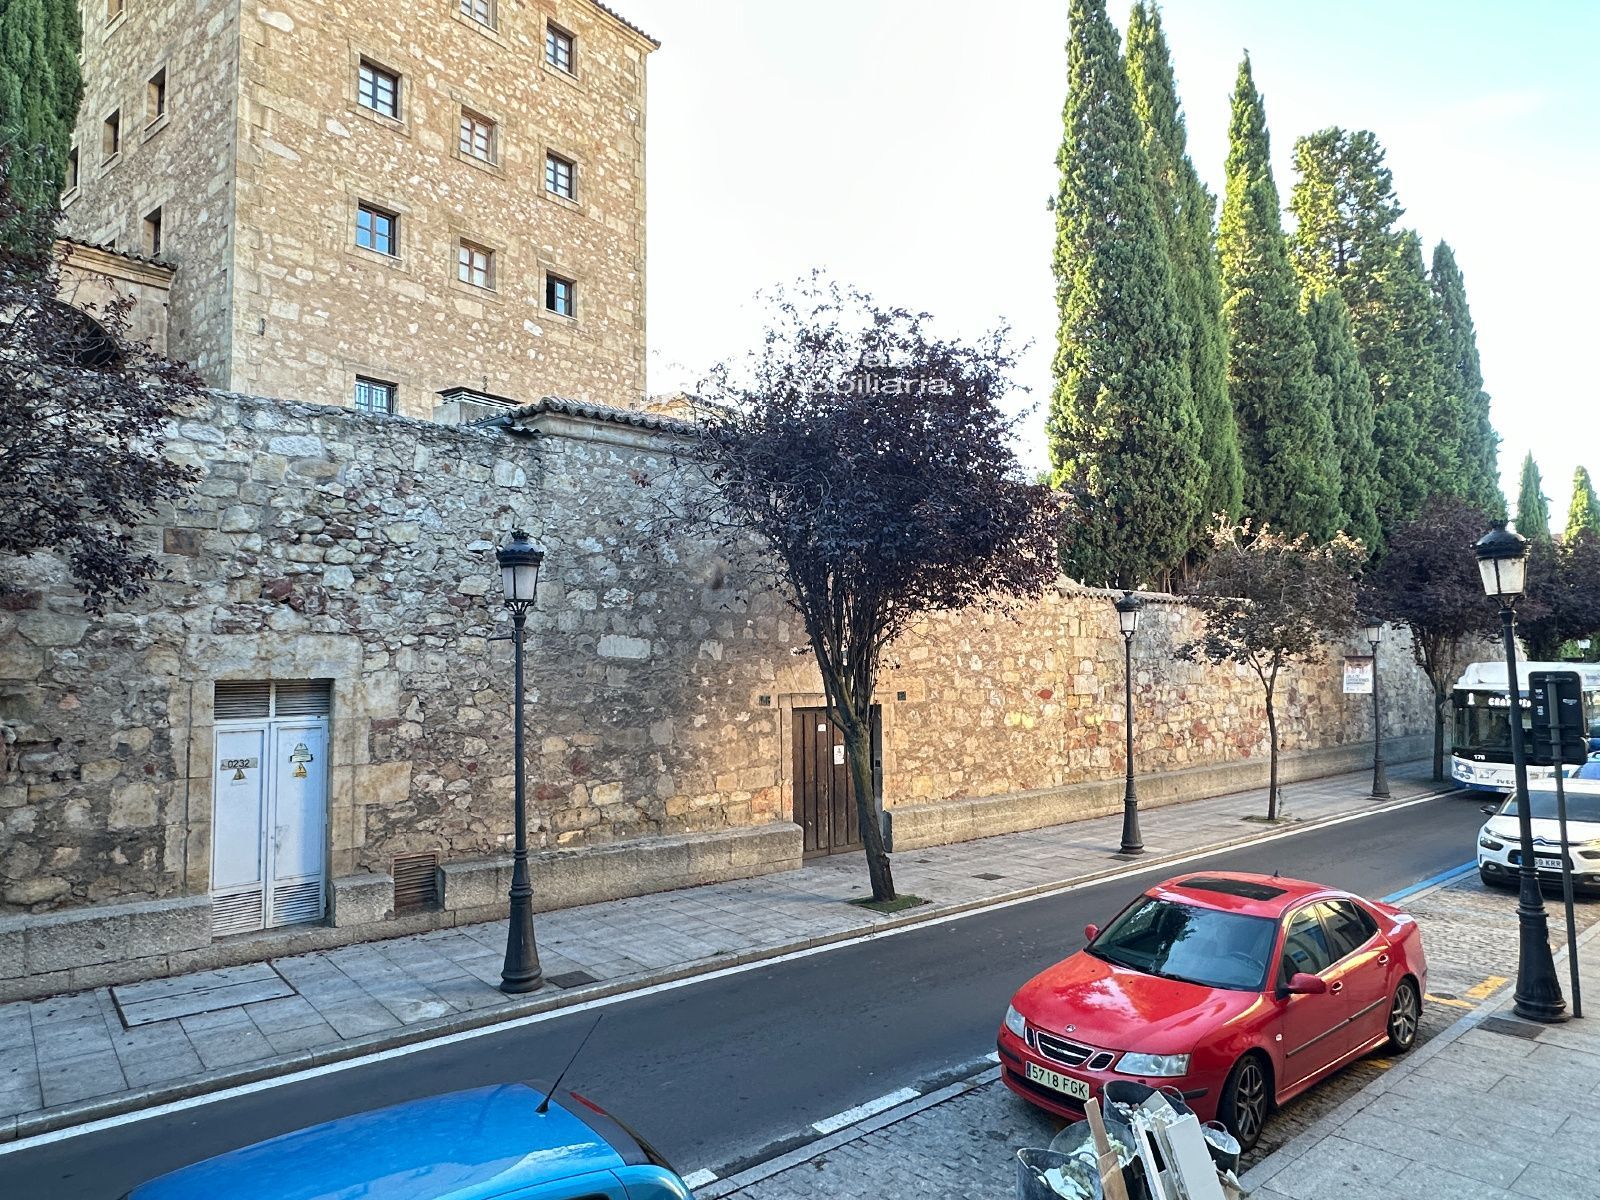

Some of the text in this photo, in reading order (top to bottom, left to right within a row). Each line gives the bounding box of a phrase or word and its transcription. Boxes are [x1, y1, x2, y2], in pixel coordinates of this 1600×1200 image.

[227, 759, 250, 769] 0232
[1032, 1065, 1086, 1098] 5718 FGK
